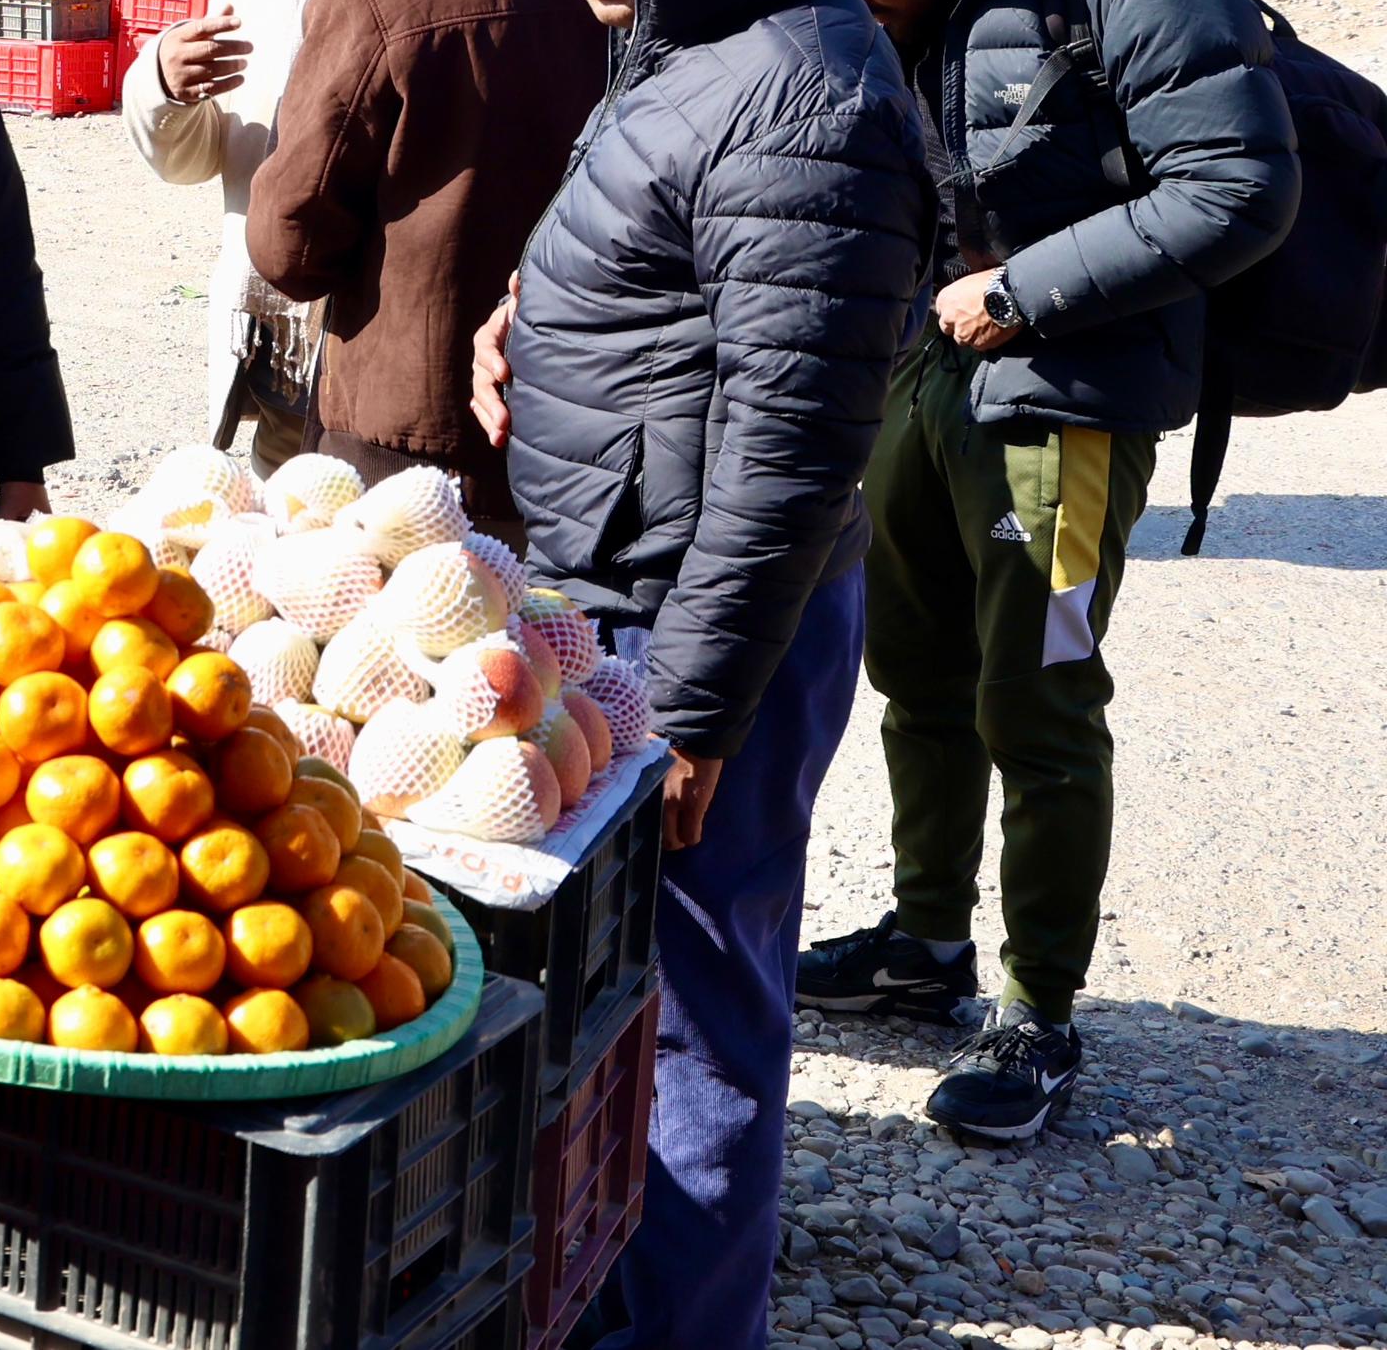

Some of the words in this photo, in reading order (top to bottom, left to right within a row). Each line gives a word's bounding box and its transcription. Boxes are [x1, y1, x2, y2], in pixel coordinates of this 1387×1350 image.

[1005, 83, 1024, 91] THE
[994, 90, 1024, 99] NORTH
[1004, 97, 1024, 105] FACE
[1049, 287, 1068, 311] 1000
[990, 529, 1032, 542] adidas
